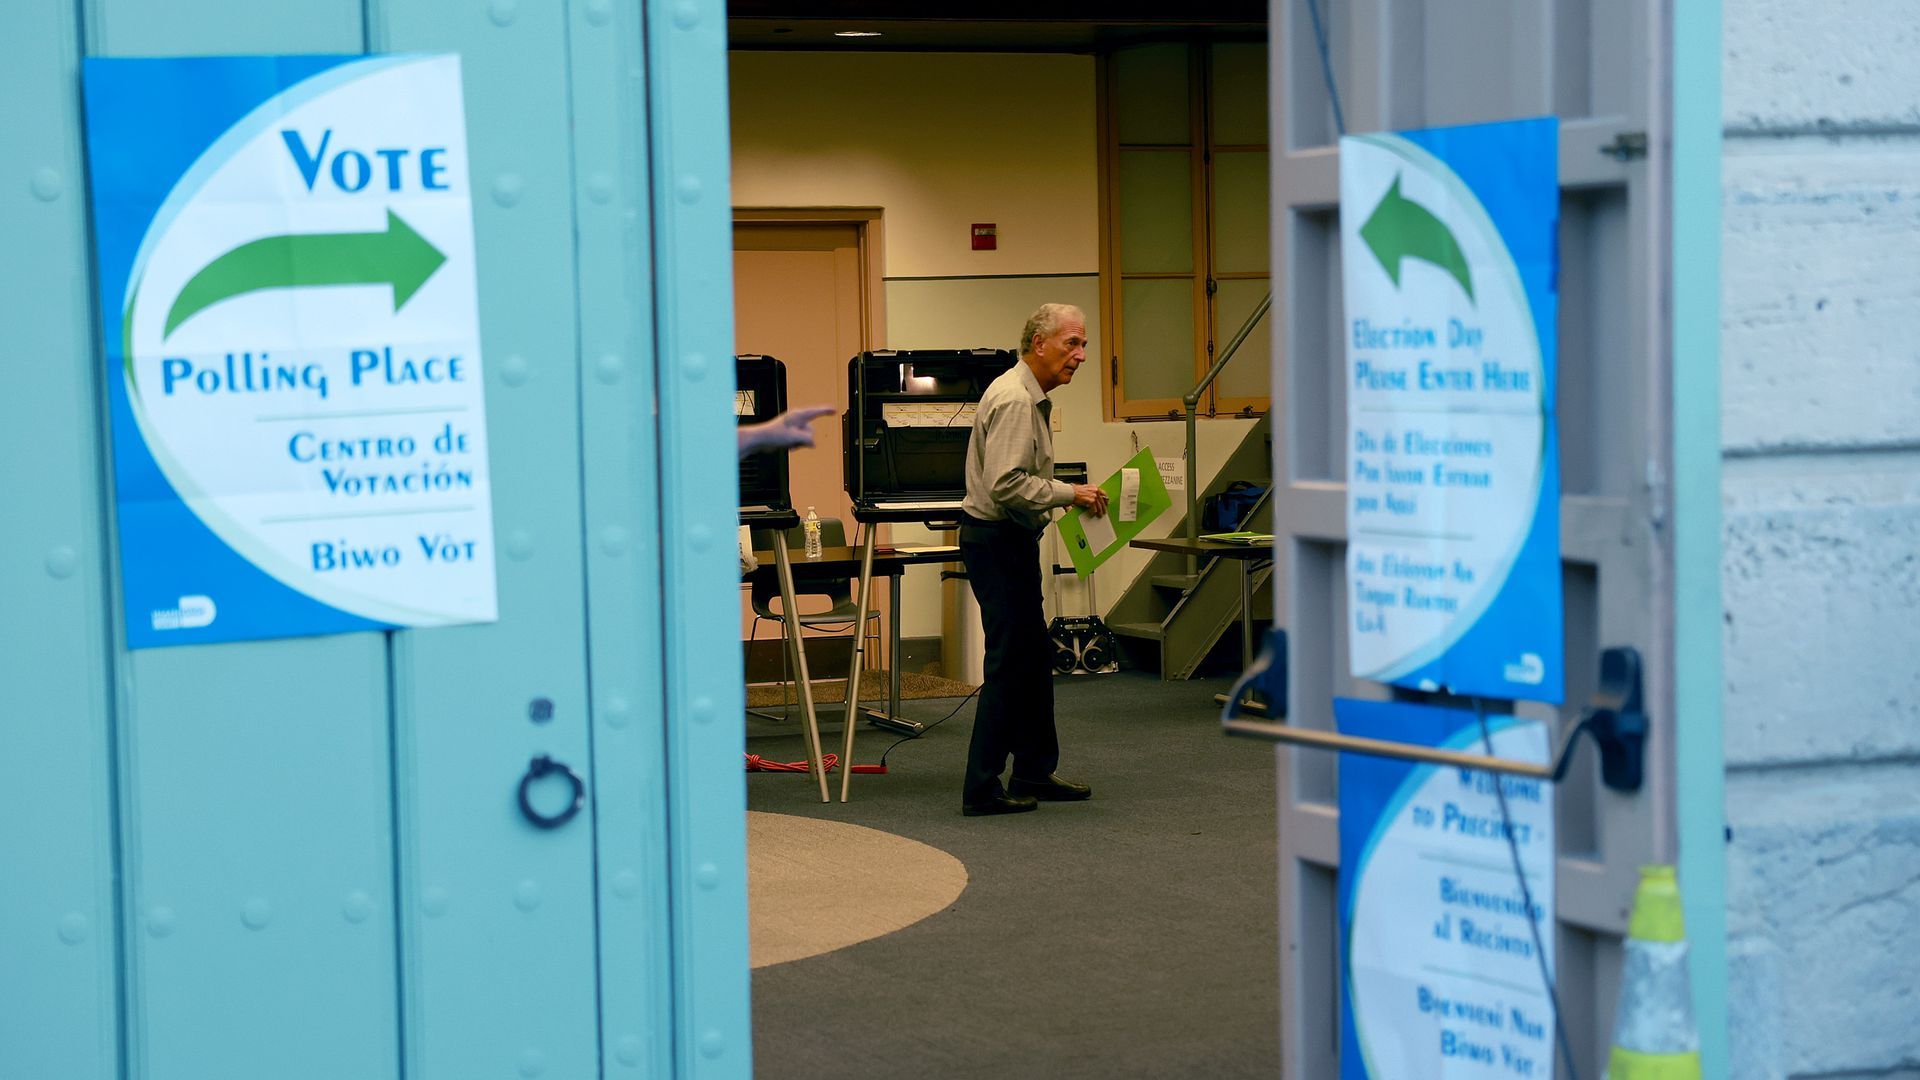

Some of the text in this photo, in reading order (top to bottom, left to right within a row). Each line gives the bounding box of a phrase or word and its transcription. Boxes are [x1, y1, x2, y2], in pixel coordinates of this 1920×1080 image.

[162, 352, 329, 400] Polling
[1158, 462, 1175, 472] ACCESS
[1160, 475, 1183, 486] EZZANINE
[311, 538, 400, 572] Biwo
